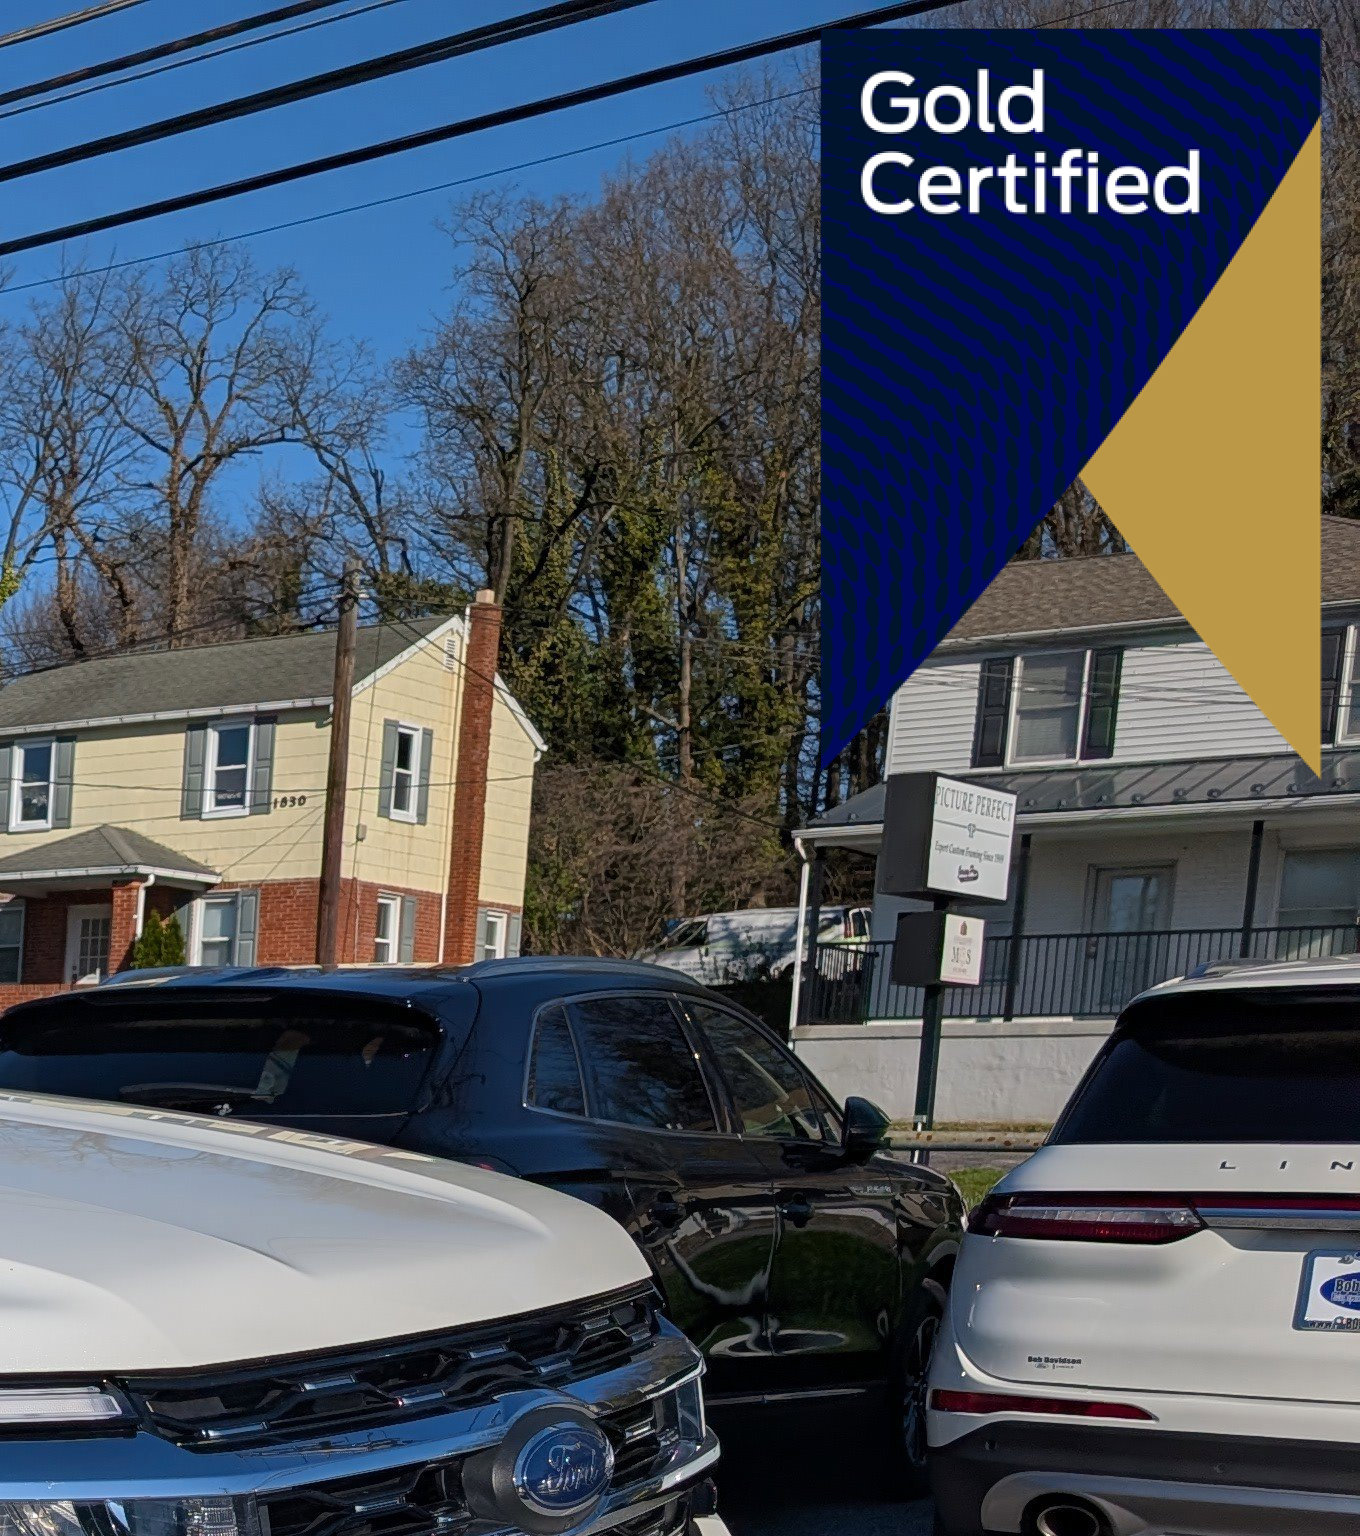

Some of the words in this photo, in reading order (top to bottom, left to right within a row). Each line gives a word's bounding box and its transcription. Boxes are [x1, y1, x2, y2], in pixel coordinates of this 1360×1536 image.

[935, 785, 974, 813] PICTURE
[975, 795, 1013, 821] PERFECT
[546, 1442, 600, 1491] Ford
